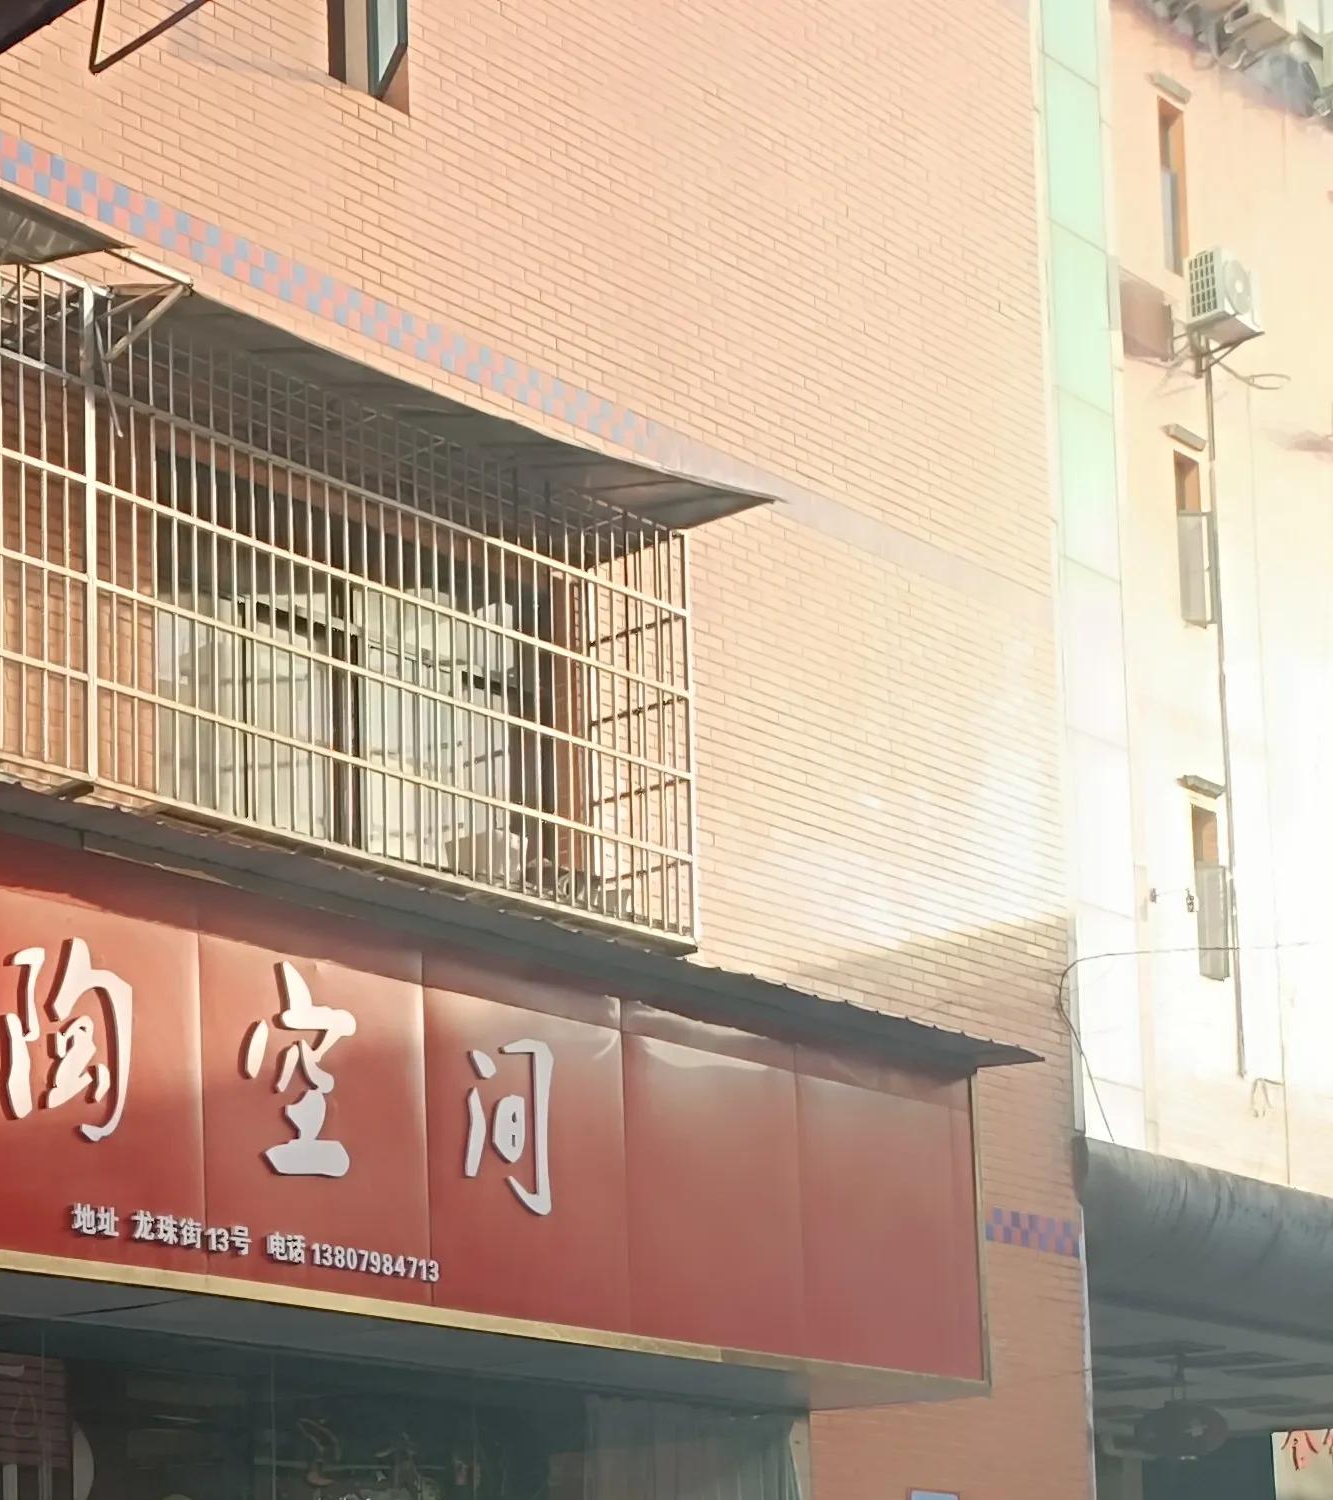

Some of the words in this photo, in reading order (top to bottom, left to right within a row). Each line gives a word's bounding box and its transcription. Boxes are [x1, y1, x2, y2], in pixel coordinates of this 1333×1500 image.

[71, 1202, 120, 1238] 地址
[130, 1209, 252, 1257] 龙珠街13号
[265, 1231, 306, 1266] 电话
[311, 1242, 440, 1283] 13807984713
